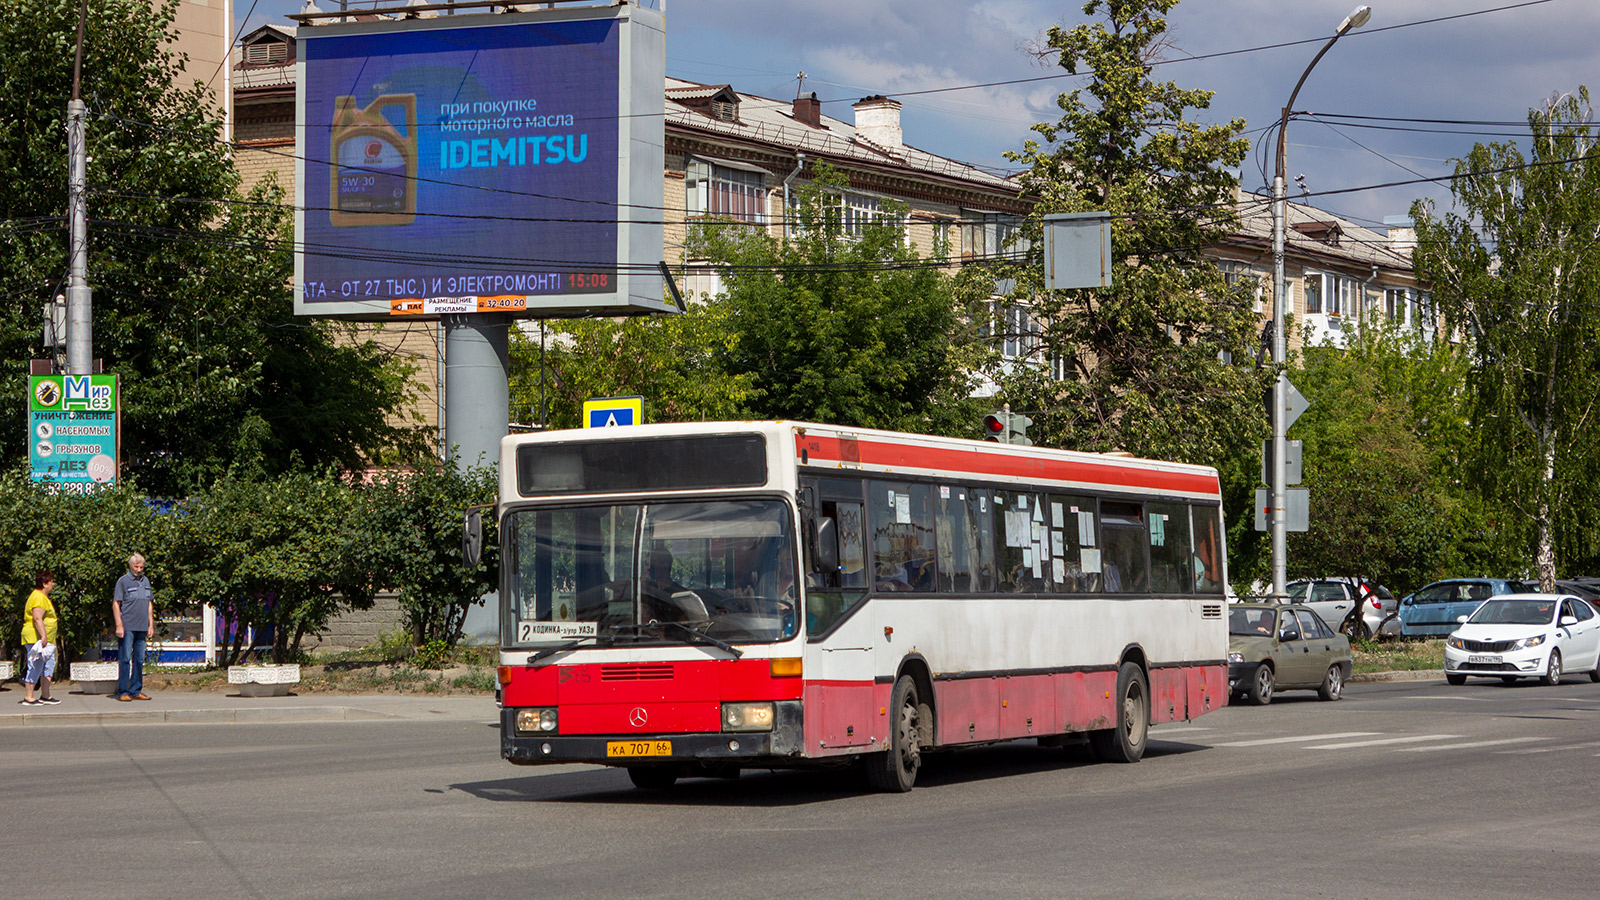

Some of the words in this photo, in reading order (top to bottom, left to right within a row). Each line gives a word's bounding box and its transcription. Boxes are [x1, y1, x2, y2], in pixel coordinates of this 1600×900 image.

[440, 103, 470, 119] при
[473, 99, 537, 116] покупке
[440, 116, 523, 135] моторного
[525, 114, 574, 128] масла
[440, 133, 588, 170] IDEMITSU
[568, 273, 608, 288] 15:08
[341, 281, 361, 297] ОТ
[365, 279, 381, 296] 27
[386, 278, 427, 299] ТЫС.)
[432, 277, 442, 294] И
[486, 299, 525, 308] 32-40-20
[34, 412, 113, 420] УНИЧТОЖЕНИЕ
[56, 427, 110, 435] НАСЕКОМЫХ
[56, 445, 101, 454] ГРЫЗУНОВ
[90, 461, 113, 474] 100%
[522, 624, 531, 640] 2
[612, 746, 626, 755] КА
[630, 743, 650, 755] 707
[656, 742, 667, 751] 66
